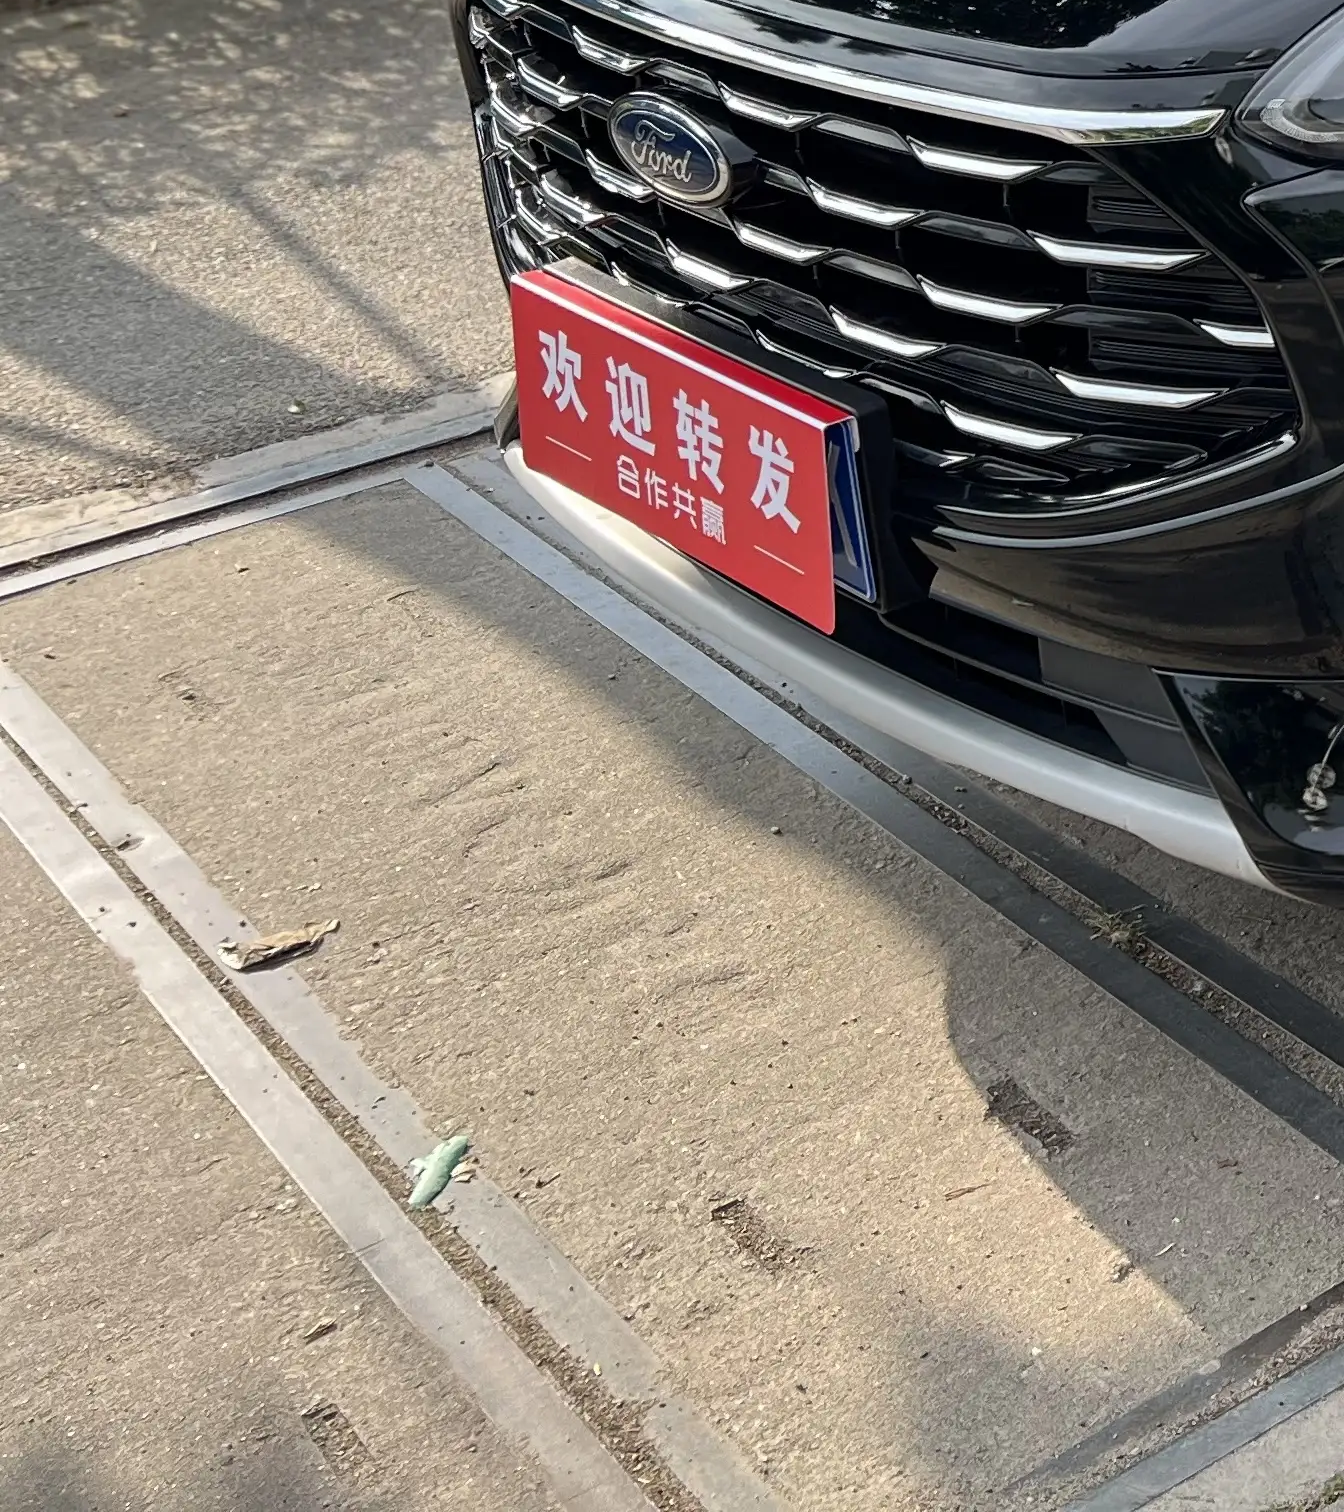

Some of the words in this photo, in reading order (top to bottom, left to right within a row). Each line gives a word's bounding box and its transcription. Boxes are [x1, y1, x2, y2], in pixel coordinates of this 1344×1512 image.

[630, 118, 692, 183] Ford
[538, 329, 801, 534] 欢迎转发
[616, 454, 727, 545] 合作共赢
